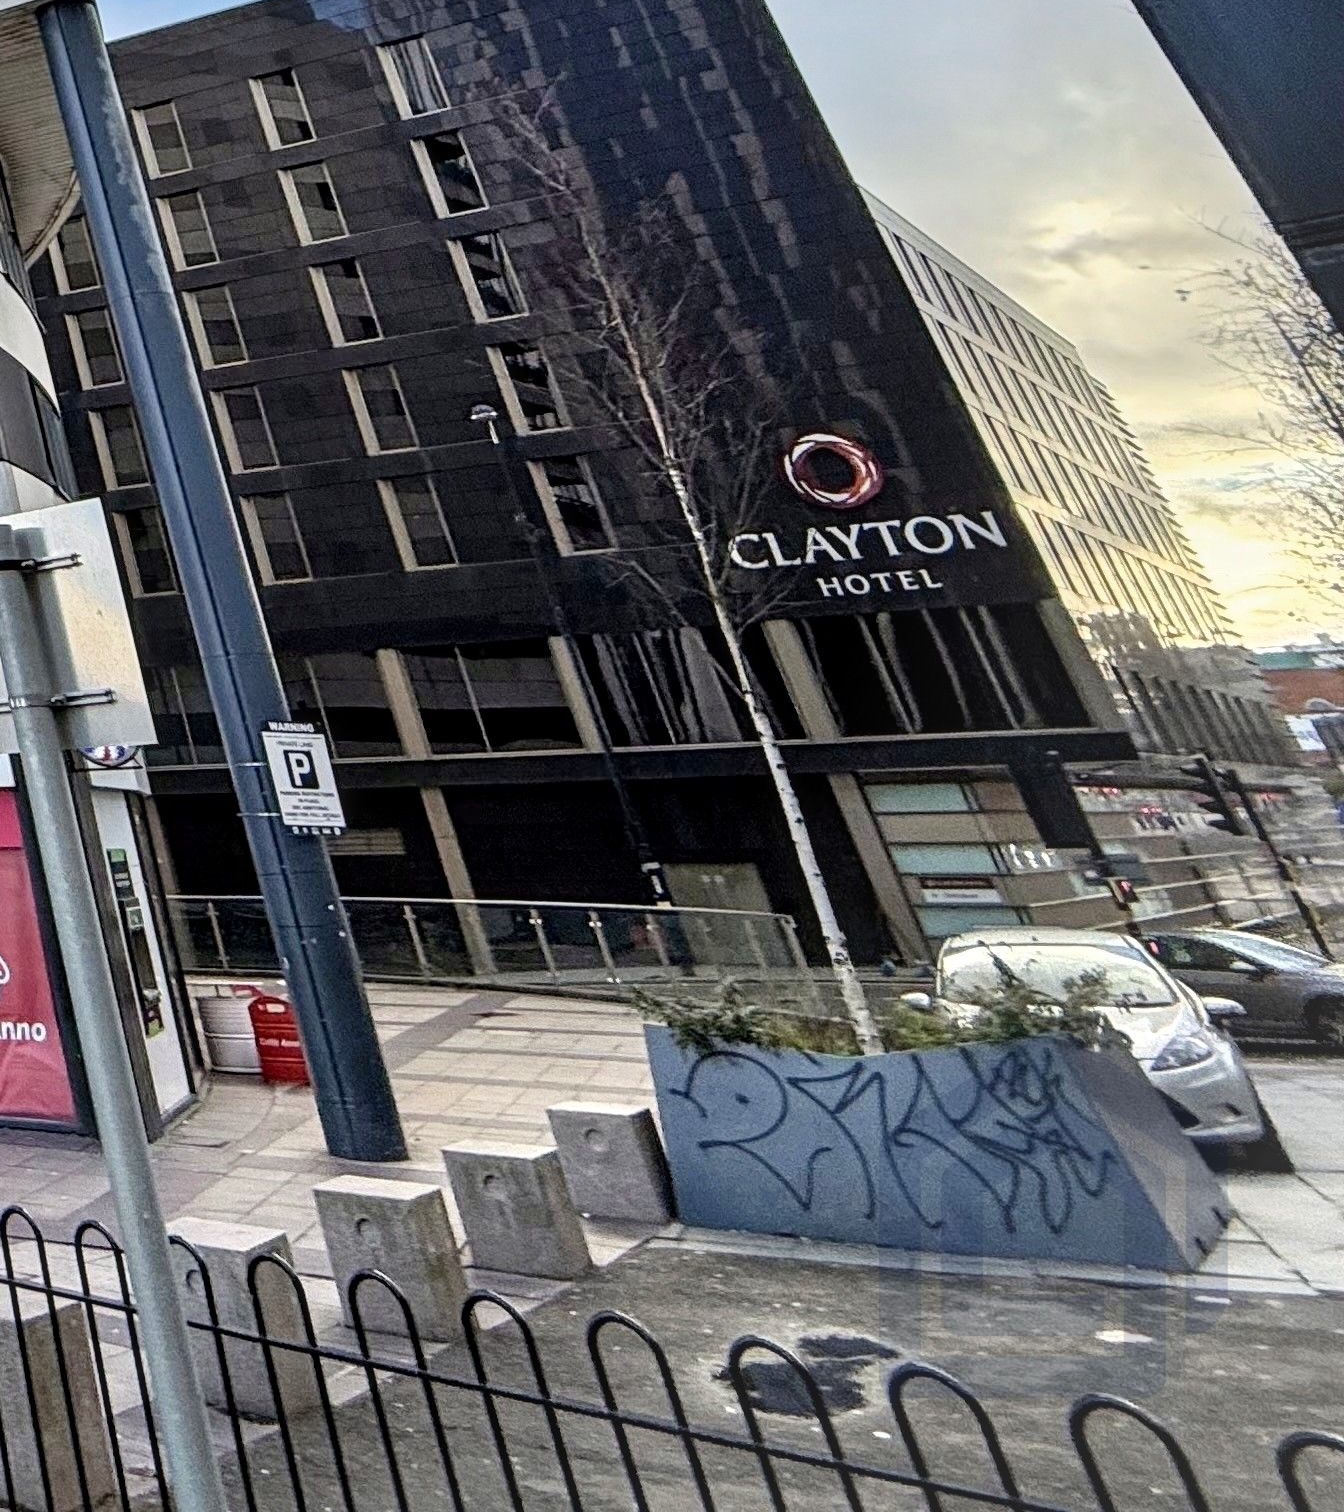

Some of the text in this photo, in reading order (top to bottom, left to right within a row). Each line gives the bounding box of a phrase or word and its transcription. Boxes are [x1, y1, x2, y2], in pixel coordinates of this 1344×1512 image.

[728, 510, 1008, 570] CLAYTON
[816, 568, 944, 598] HOTEL
[268, 721, 315, 733] WARNING
[288, 753, 311, 787] P
